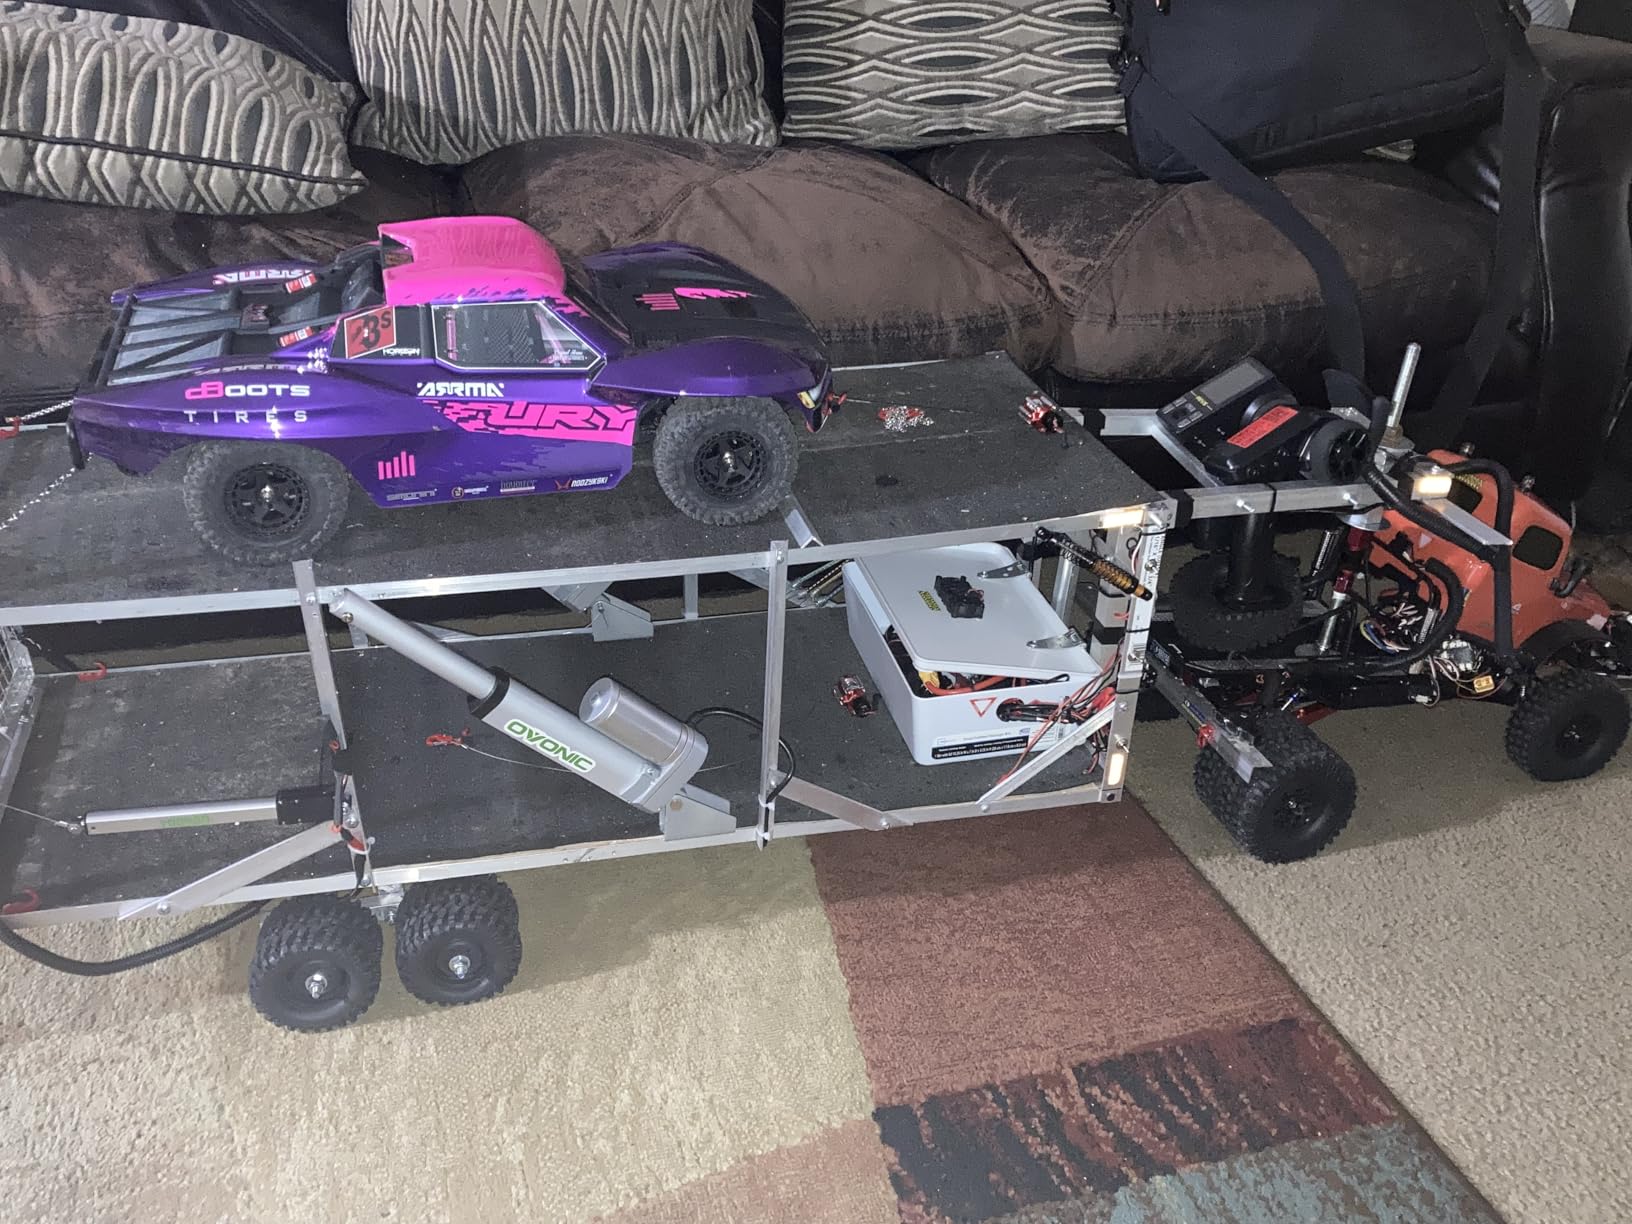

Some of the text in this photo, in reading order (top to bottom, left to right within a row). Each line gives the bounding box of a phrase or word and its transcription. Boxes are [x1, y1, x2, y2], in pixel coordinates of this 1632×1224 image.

[416, 382, 505, 398] ARRMA
[183, 409, 308, 424] TIRES
[443, 401, 638, 434] FURY
[505, 719, 595, 772] OVONIC
